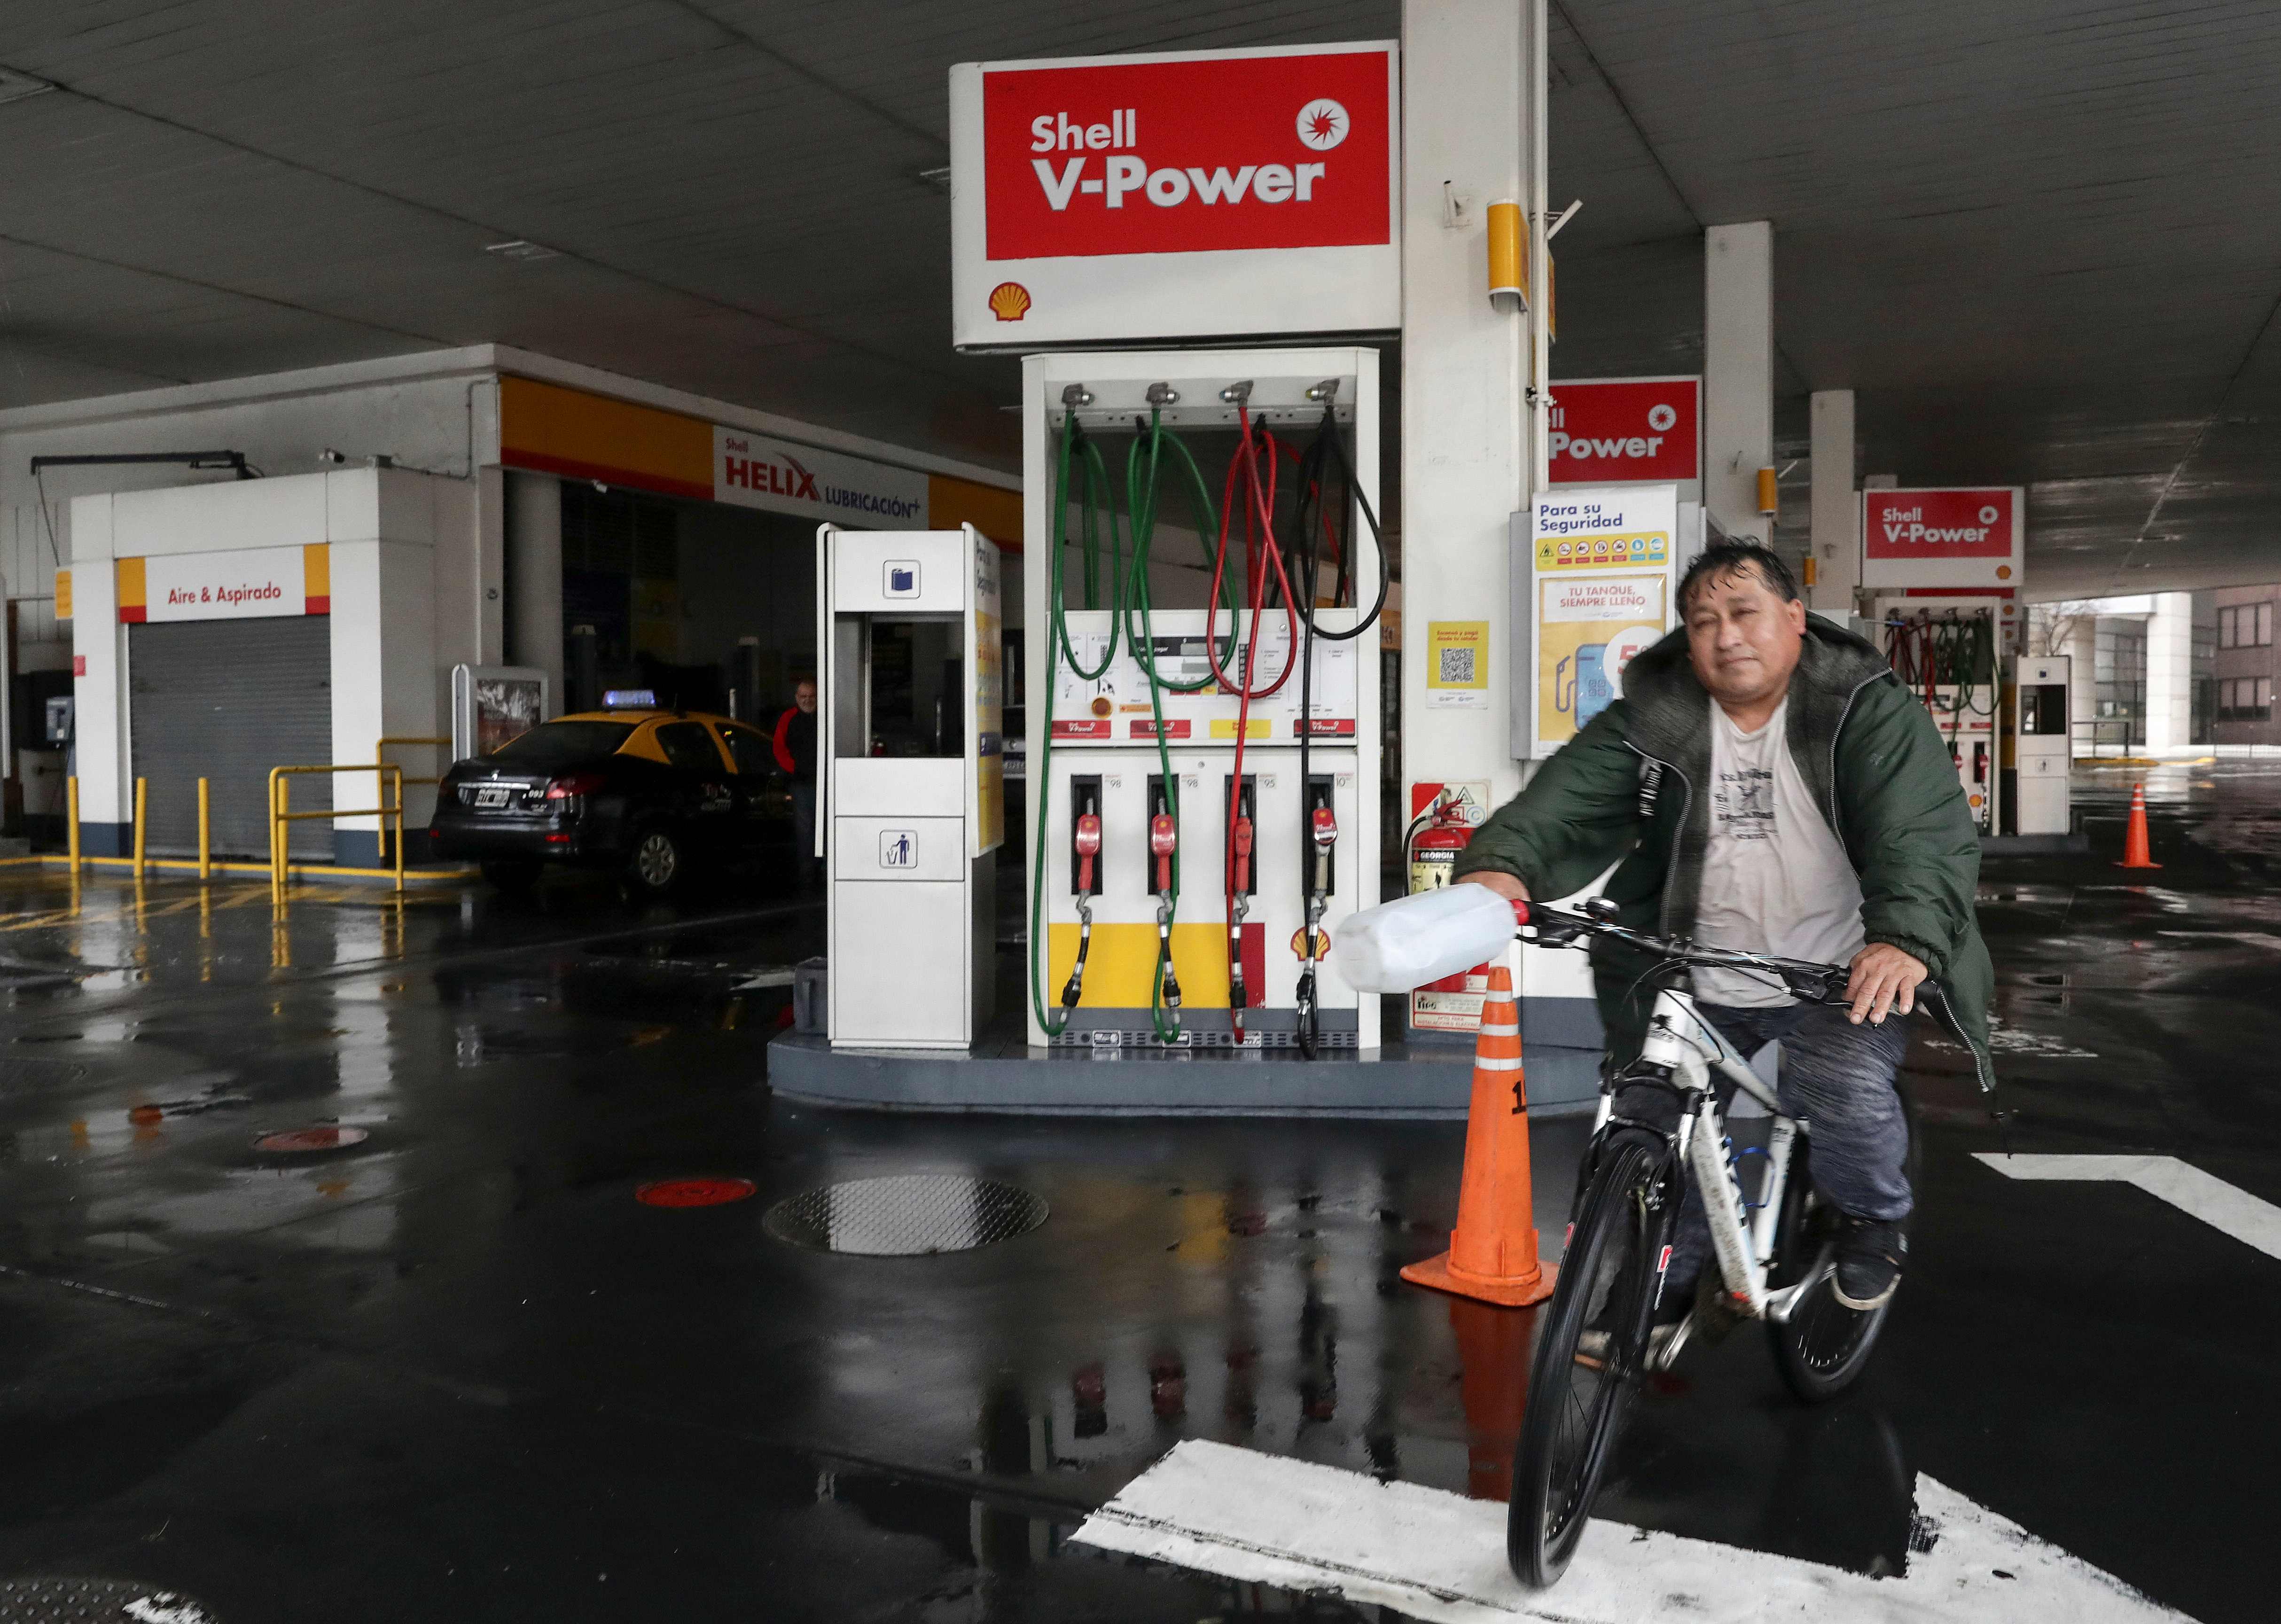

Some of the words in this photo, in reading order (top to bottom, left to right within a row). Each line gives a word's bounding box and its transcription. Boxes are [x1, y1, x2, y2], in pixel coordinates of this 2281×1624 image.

[1031, 109, 1136, 152] Shell
[1031, 155, 1325, 211] V-Power
[726, 436, 749, 453] Shell
[1549, 431, 1664, 460] Power
[725, 452, 821, 501] HELIX
[1540, 504, 1577, 516] Para
[1584, 503, 1601, 514] su
[1883, 507, 1922, 522] Shell
[1540, 513, 1623, 533] Seguridad
[1883, 523, 1990, 543] V-Power
[168, 587, 196, 605] Aire
[201, 586, 211, 602] &
[217, 580, 281, 607] Aspirado
[1560, 598, 1606, 608] SIEMPRE
[1609, 596, 1646, 606] LLENO
[1570, 587, 1582, 597] TU
[1110, 779, 1121, 788] 98
[1187, 779, 1198, 788] 98
[1512, 1080, 1527, 1116] 1
